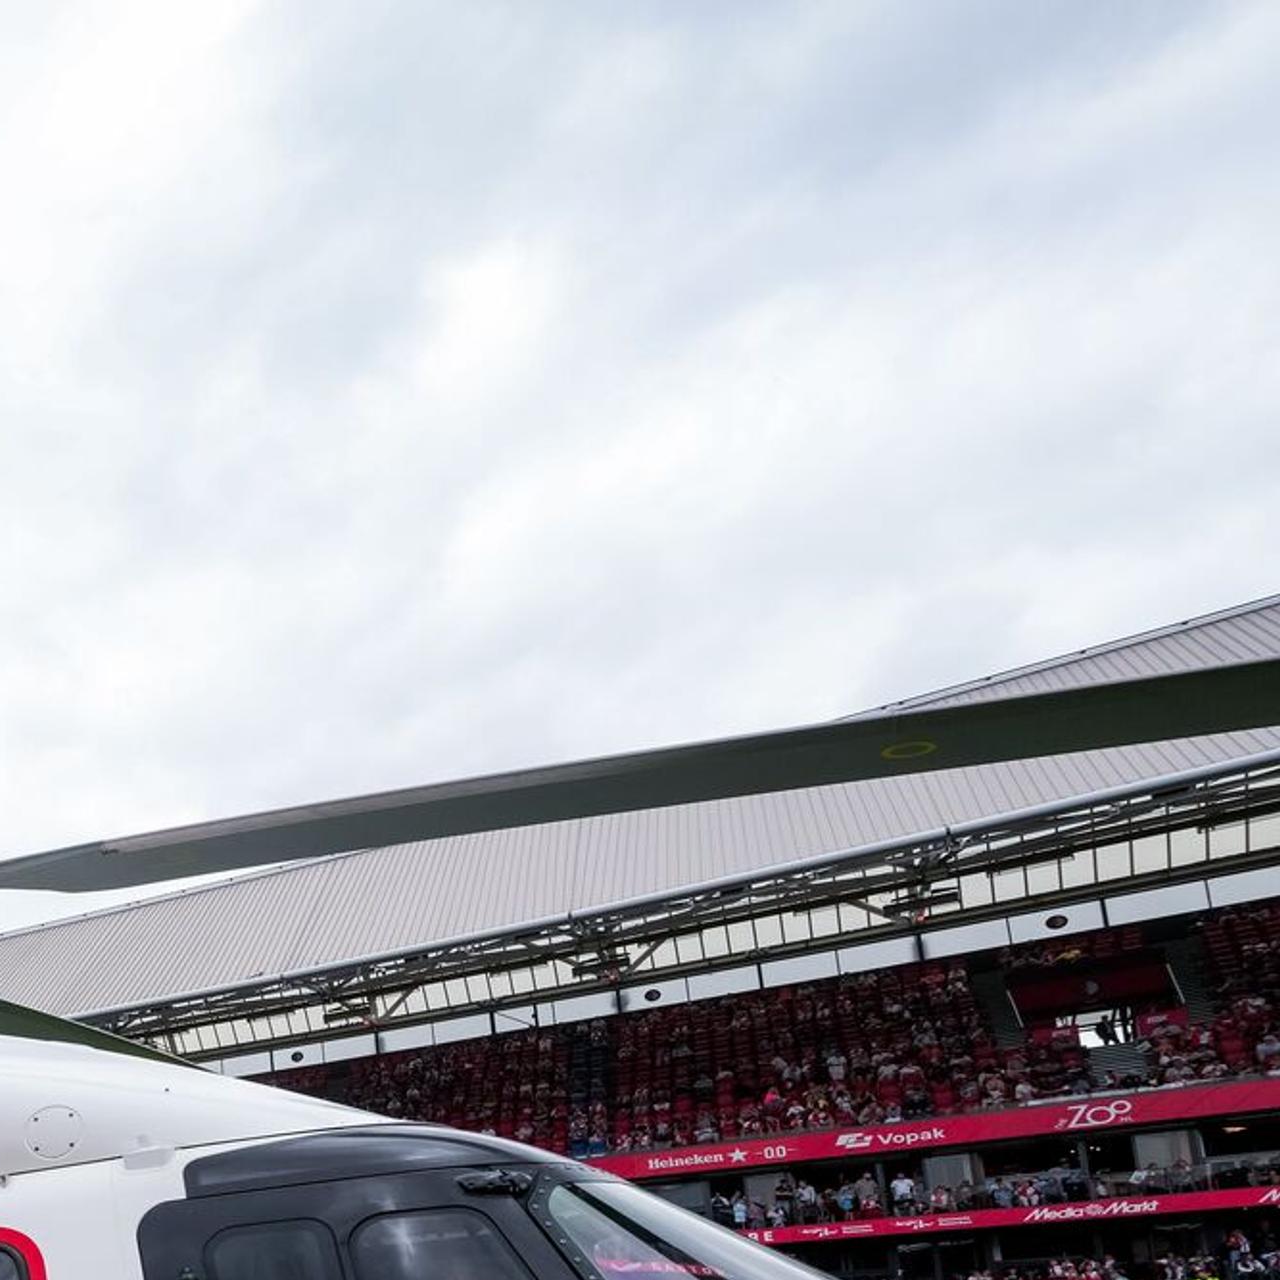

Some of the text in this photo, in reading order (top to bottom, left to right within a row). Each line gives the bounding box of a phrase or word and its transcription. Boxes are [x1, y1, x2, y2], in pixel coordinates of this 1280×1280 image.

[877, 1127, 946, 1146] Vopak
[647, 1152, 724, 1170] Heineken
[1024, 1200, 1159, 1223] Media Markt
